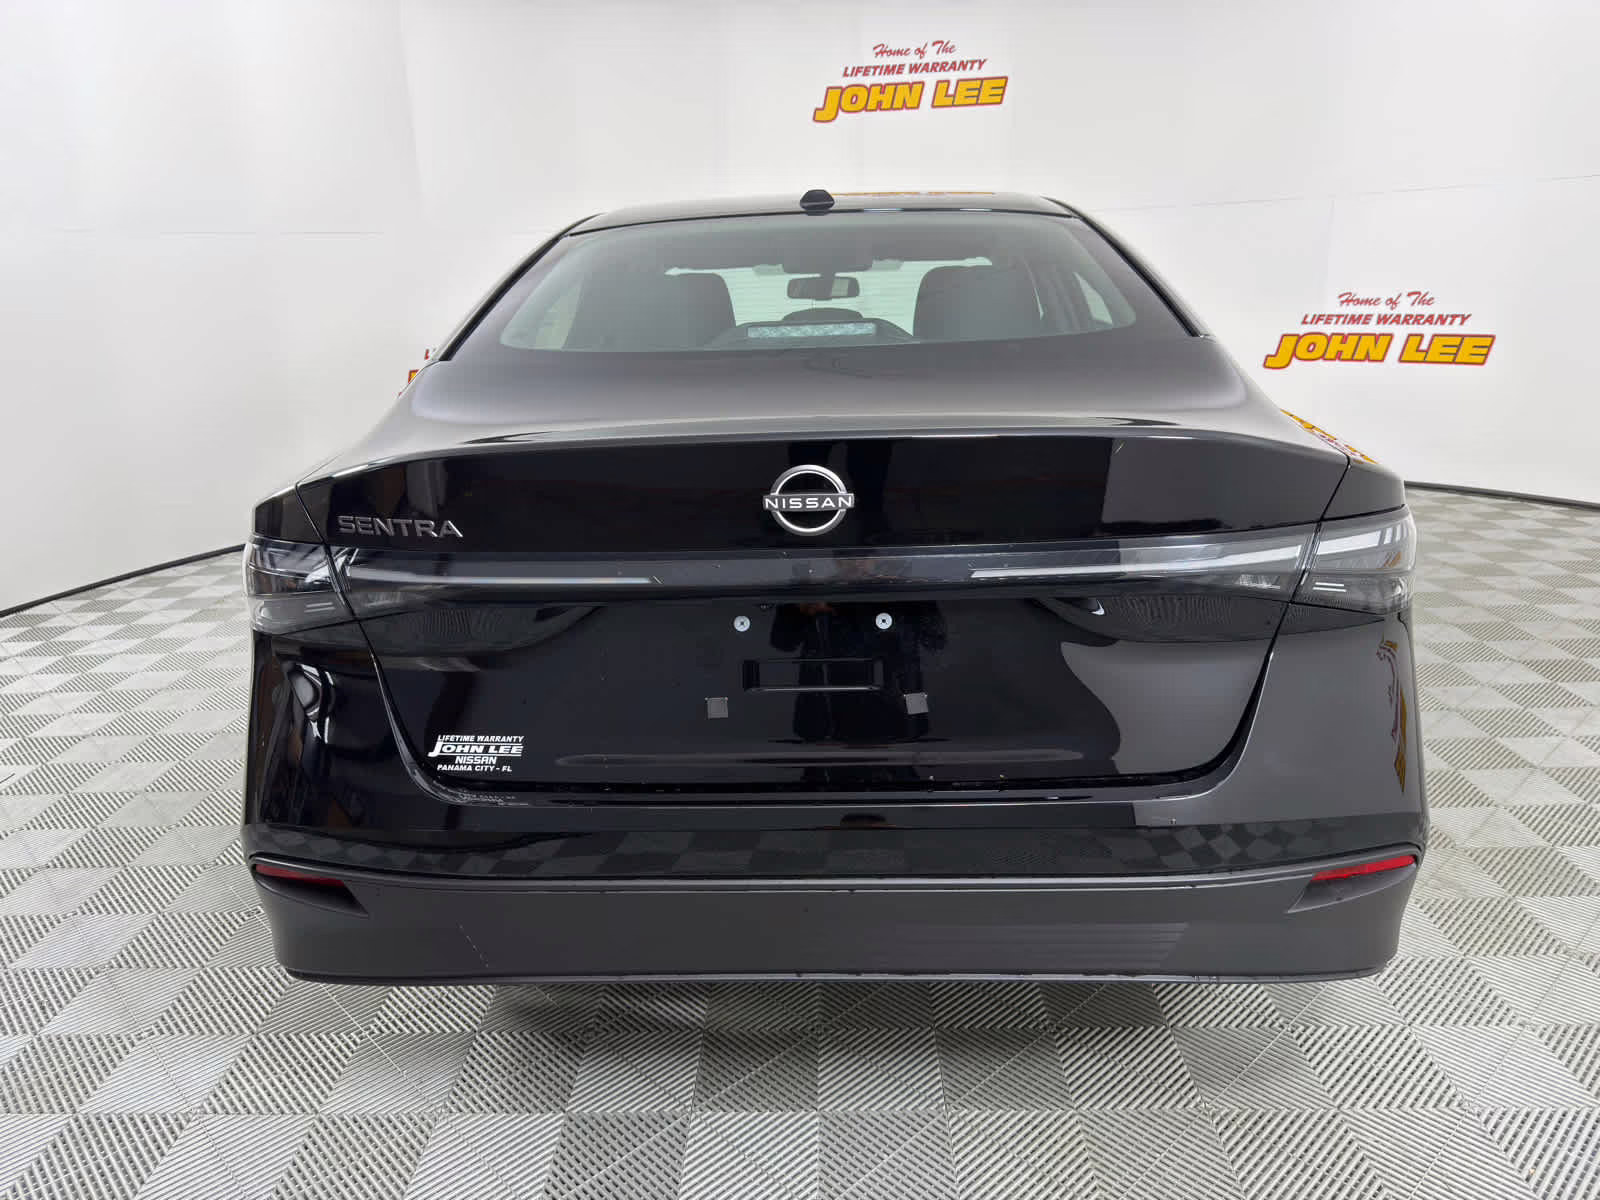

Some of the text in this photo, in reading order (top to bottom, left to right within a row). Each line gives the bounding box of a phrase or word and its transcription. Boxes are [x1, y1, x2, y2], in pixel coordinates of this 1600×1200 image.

[872, 40, 957, 59] Home of The
[842, 58, 987, 77] LIFETIME WARRANTY
[813, 76, 1008, 122] JOHN LEE
[1337, 291, 1435, 310] Home of The
[1301, 313, 1472, 326] LIFETIME WARRANTY
[1263, 332, 1496, 369] JOHN LEE
[764, 496, 852, 509] NISSAN
[337, 515, 463, 538] SENTRA
[477, 735, 525, 743] WARRANTY
[427, 741, 524, 757] JOHN LEE
[455, 756, 497, 764] NISSAN
